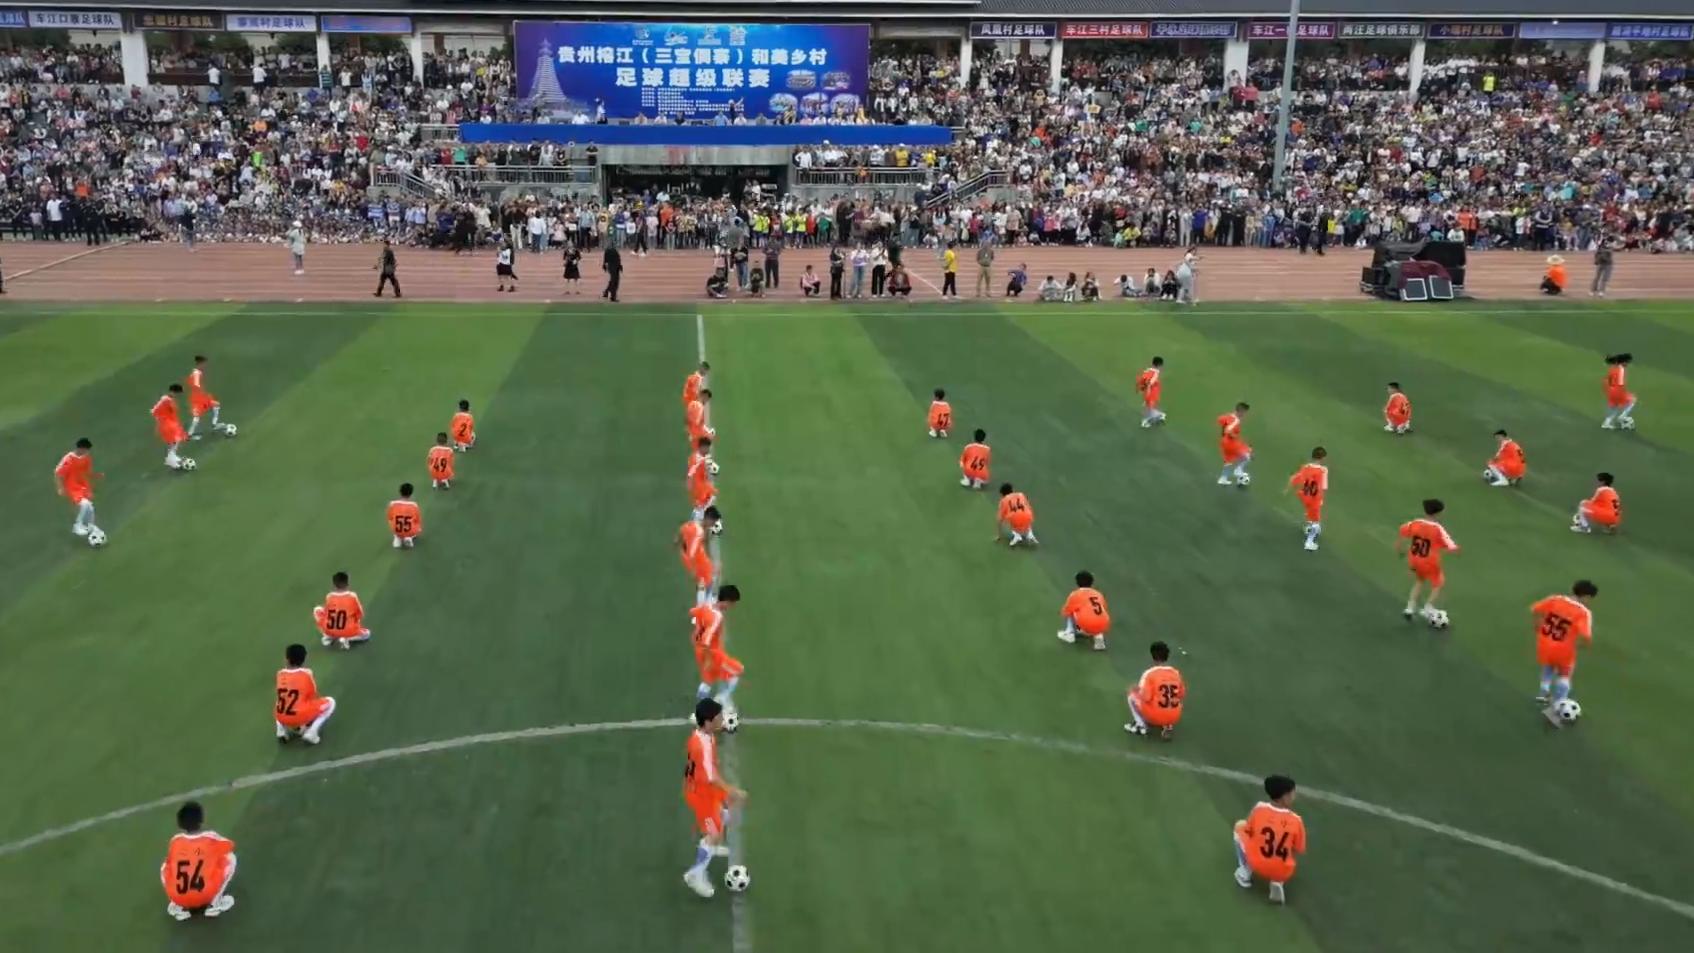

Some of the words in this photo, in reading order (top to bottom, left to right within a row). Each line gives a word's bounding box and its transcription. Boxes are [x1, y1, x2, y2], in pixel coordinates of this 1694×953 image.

[1066, 24, 1143, 35] 车江三村足球队
[1252, 25, 1329, 36] 车江一足球队
[615, 66, 770, 88] 足球超级联赛
[459, 424, 467, 437] 2
[433, 457, 447, 473] 49
[1008, 498, 1025, 513] 44
[395, 515, 412, 534] 55
[1411, 536, 1431, 558] 50
[1089, 596, 1102, 616] 5
[326, 609, 347, 630] 50
[1542, 614, 1573, 642] 55
[276, 688, 300, 716] 52
[1158, 684, 1180, 709] 35
[1260, 826, 1290, 862] 34
[175, 859, 205, 895] 54
